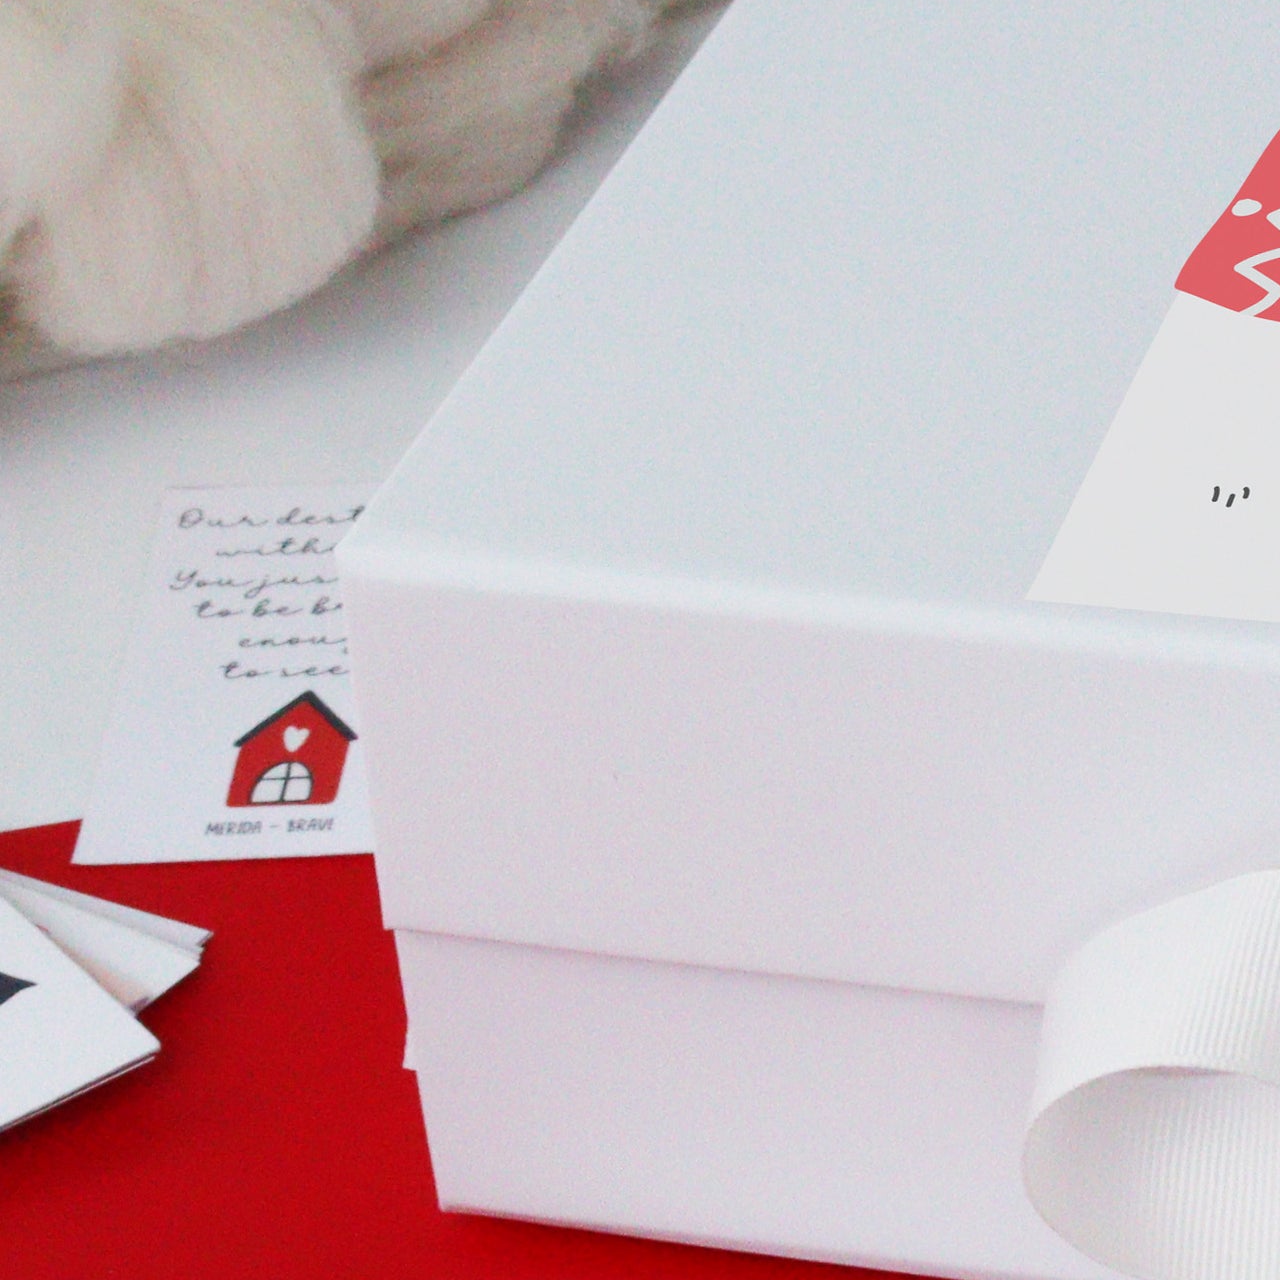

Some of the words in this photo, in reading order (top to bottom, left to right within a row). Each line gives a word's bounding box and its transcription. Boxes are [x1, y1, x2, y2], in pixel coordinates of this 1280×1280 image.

[178, 508, 267, 528] Our
[169, 570, 252, 590] You
[194, 600, 243, 618] to
[252, 598, 303, 617] be
[238, 636, 348, 654] enou
[220, 661, 273, 679] to
